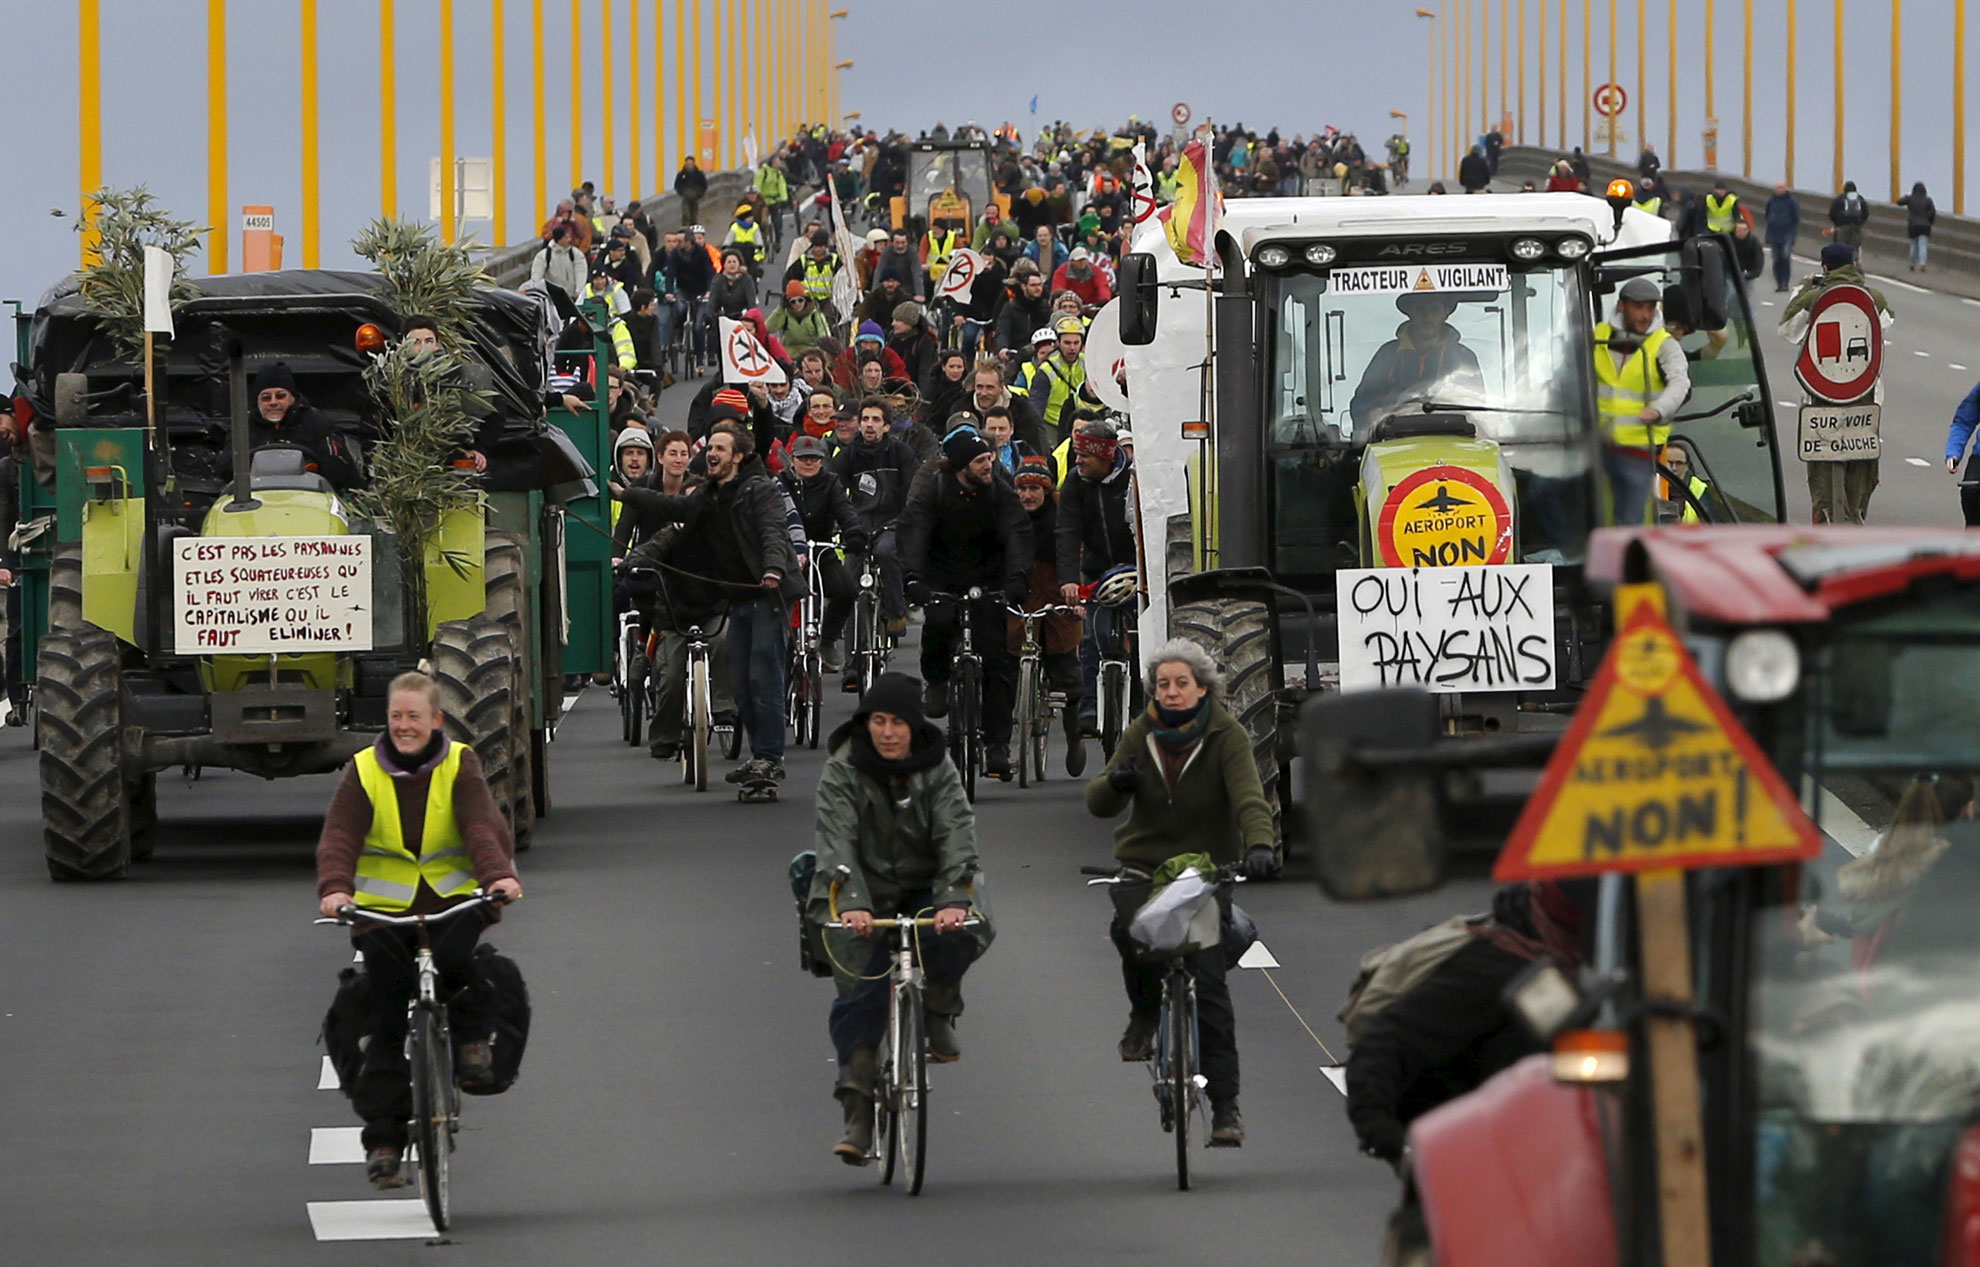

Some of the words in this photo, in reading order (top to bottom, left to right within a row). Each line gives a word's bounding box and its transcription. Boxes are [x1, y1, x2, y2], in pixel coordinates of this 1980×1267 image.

[1378, 241, 1468, 256] ARES
[1332, 268, 1409, 293] TRACTEUR
[1437, 267, 1505, 288] VIGILANT
[1810, 416, 1838, 430] SUR
[1845, 414, 1873, 428] VOIE
[1804, 440, 1822, 452] DE
[1830, 436, 1878, 452] GAUCHE
[1403, 514, 1487, 536] AEROPORT
[181, 543, 227, 561] C'EST
[231, 545, 257, 561] PAS
[261, 543, 287, 558] LES
[1412, 535, 1486, 568] NON
[207, 590, 241, 605] FAUT
[286, 585, 320, 601] C'EST
[331, 585, 349, 598] LE
[1448, 568, 1534, 621] AUX
[197, 629, 241, 647] FAUT
[1364, 624, 1551, 687] PAYSANS
